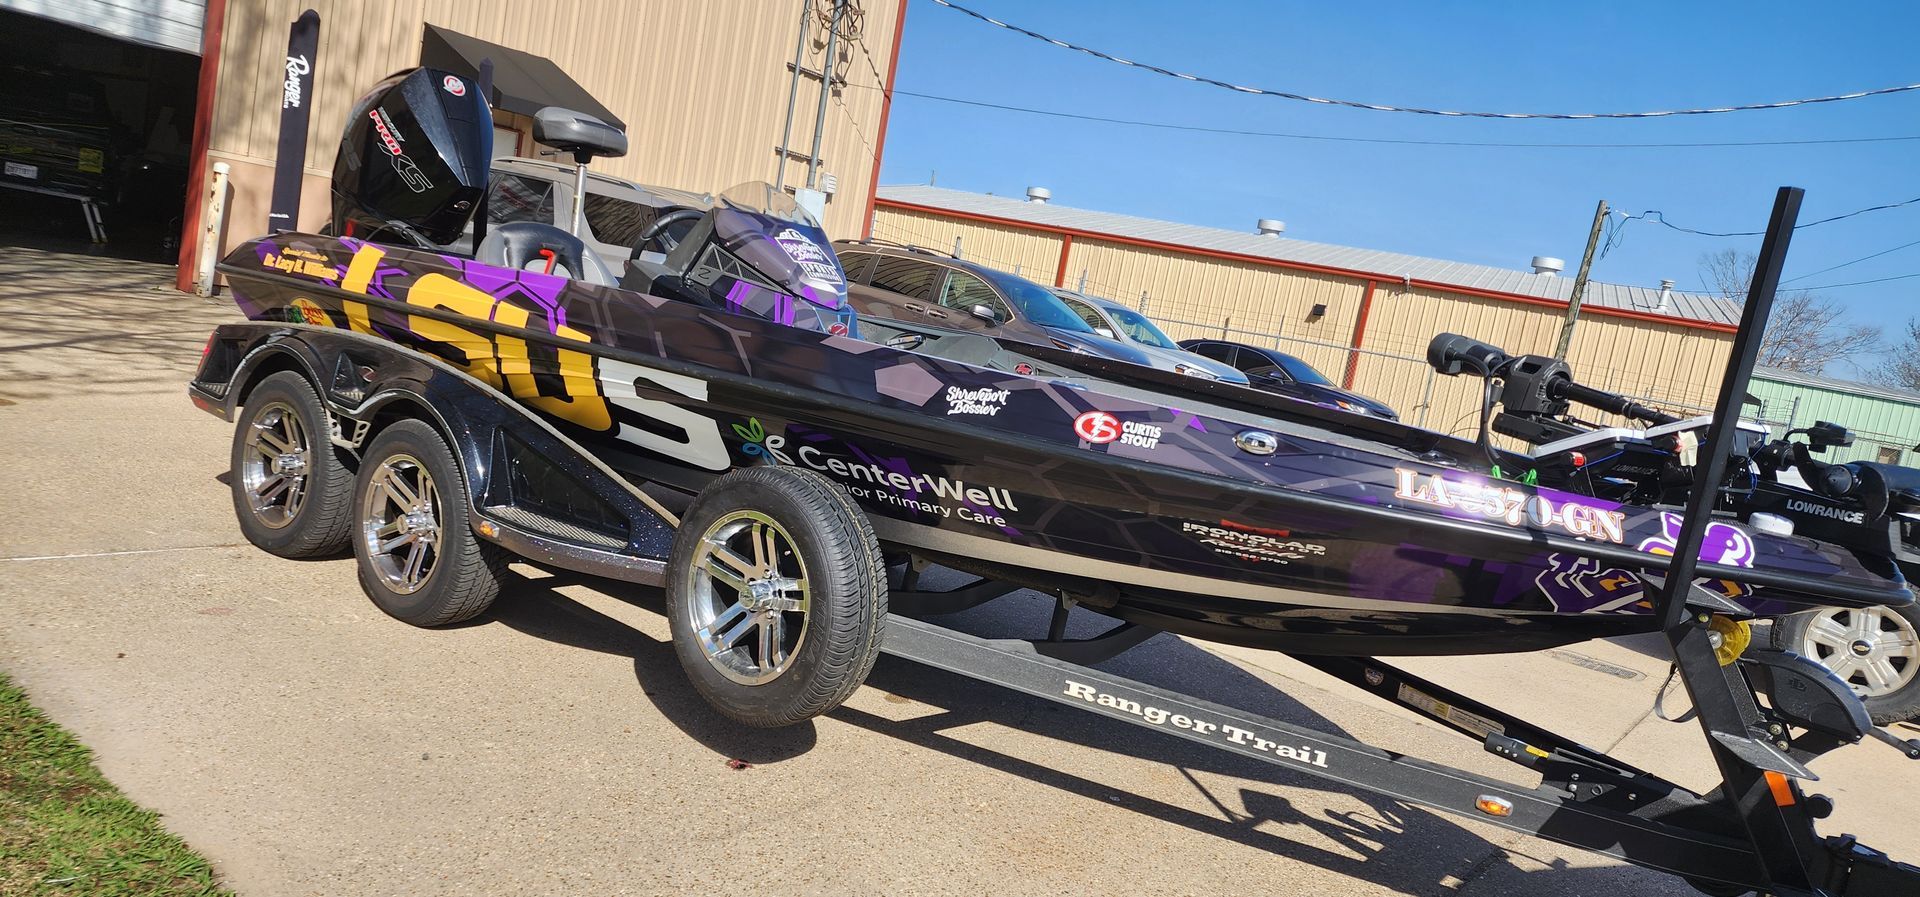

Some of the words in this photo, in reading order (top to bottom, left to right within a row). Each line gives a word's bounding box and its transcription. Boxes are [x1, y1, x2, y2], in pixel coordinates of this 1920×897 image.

[285, 54, 310, 108] Ranger
[369, 109, 402, 156] PRO
[376, 141, 434, 193] XS
[802, 263, 837, 276] SPORTS
[946, 386, 1011, 406] Shreveport
[947, 400, 1001, 416] Bossier
[1120, 433, 1159, 450] STOUT
[1122, 420, 1162, 438] CURTIS
[798, 445, 1019, 512] CenterWell
[841, 483, 870, 500] nior
[877, 490, 951, 518] Primary
[956, 507, 1007, 528] Care
[1786, 498, 1865, 525] LOWRANCE
[1183, 522, 1327, 552] IRONCLAD
[1063, 679, 1217, 736] Ranger
[1222, 723, 1330, 769] Trail
